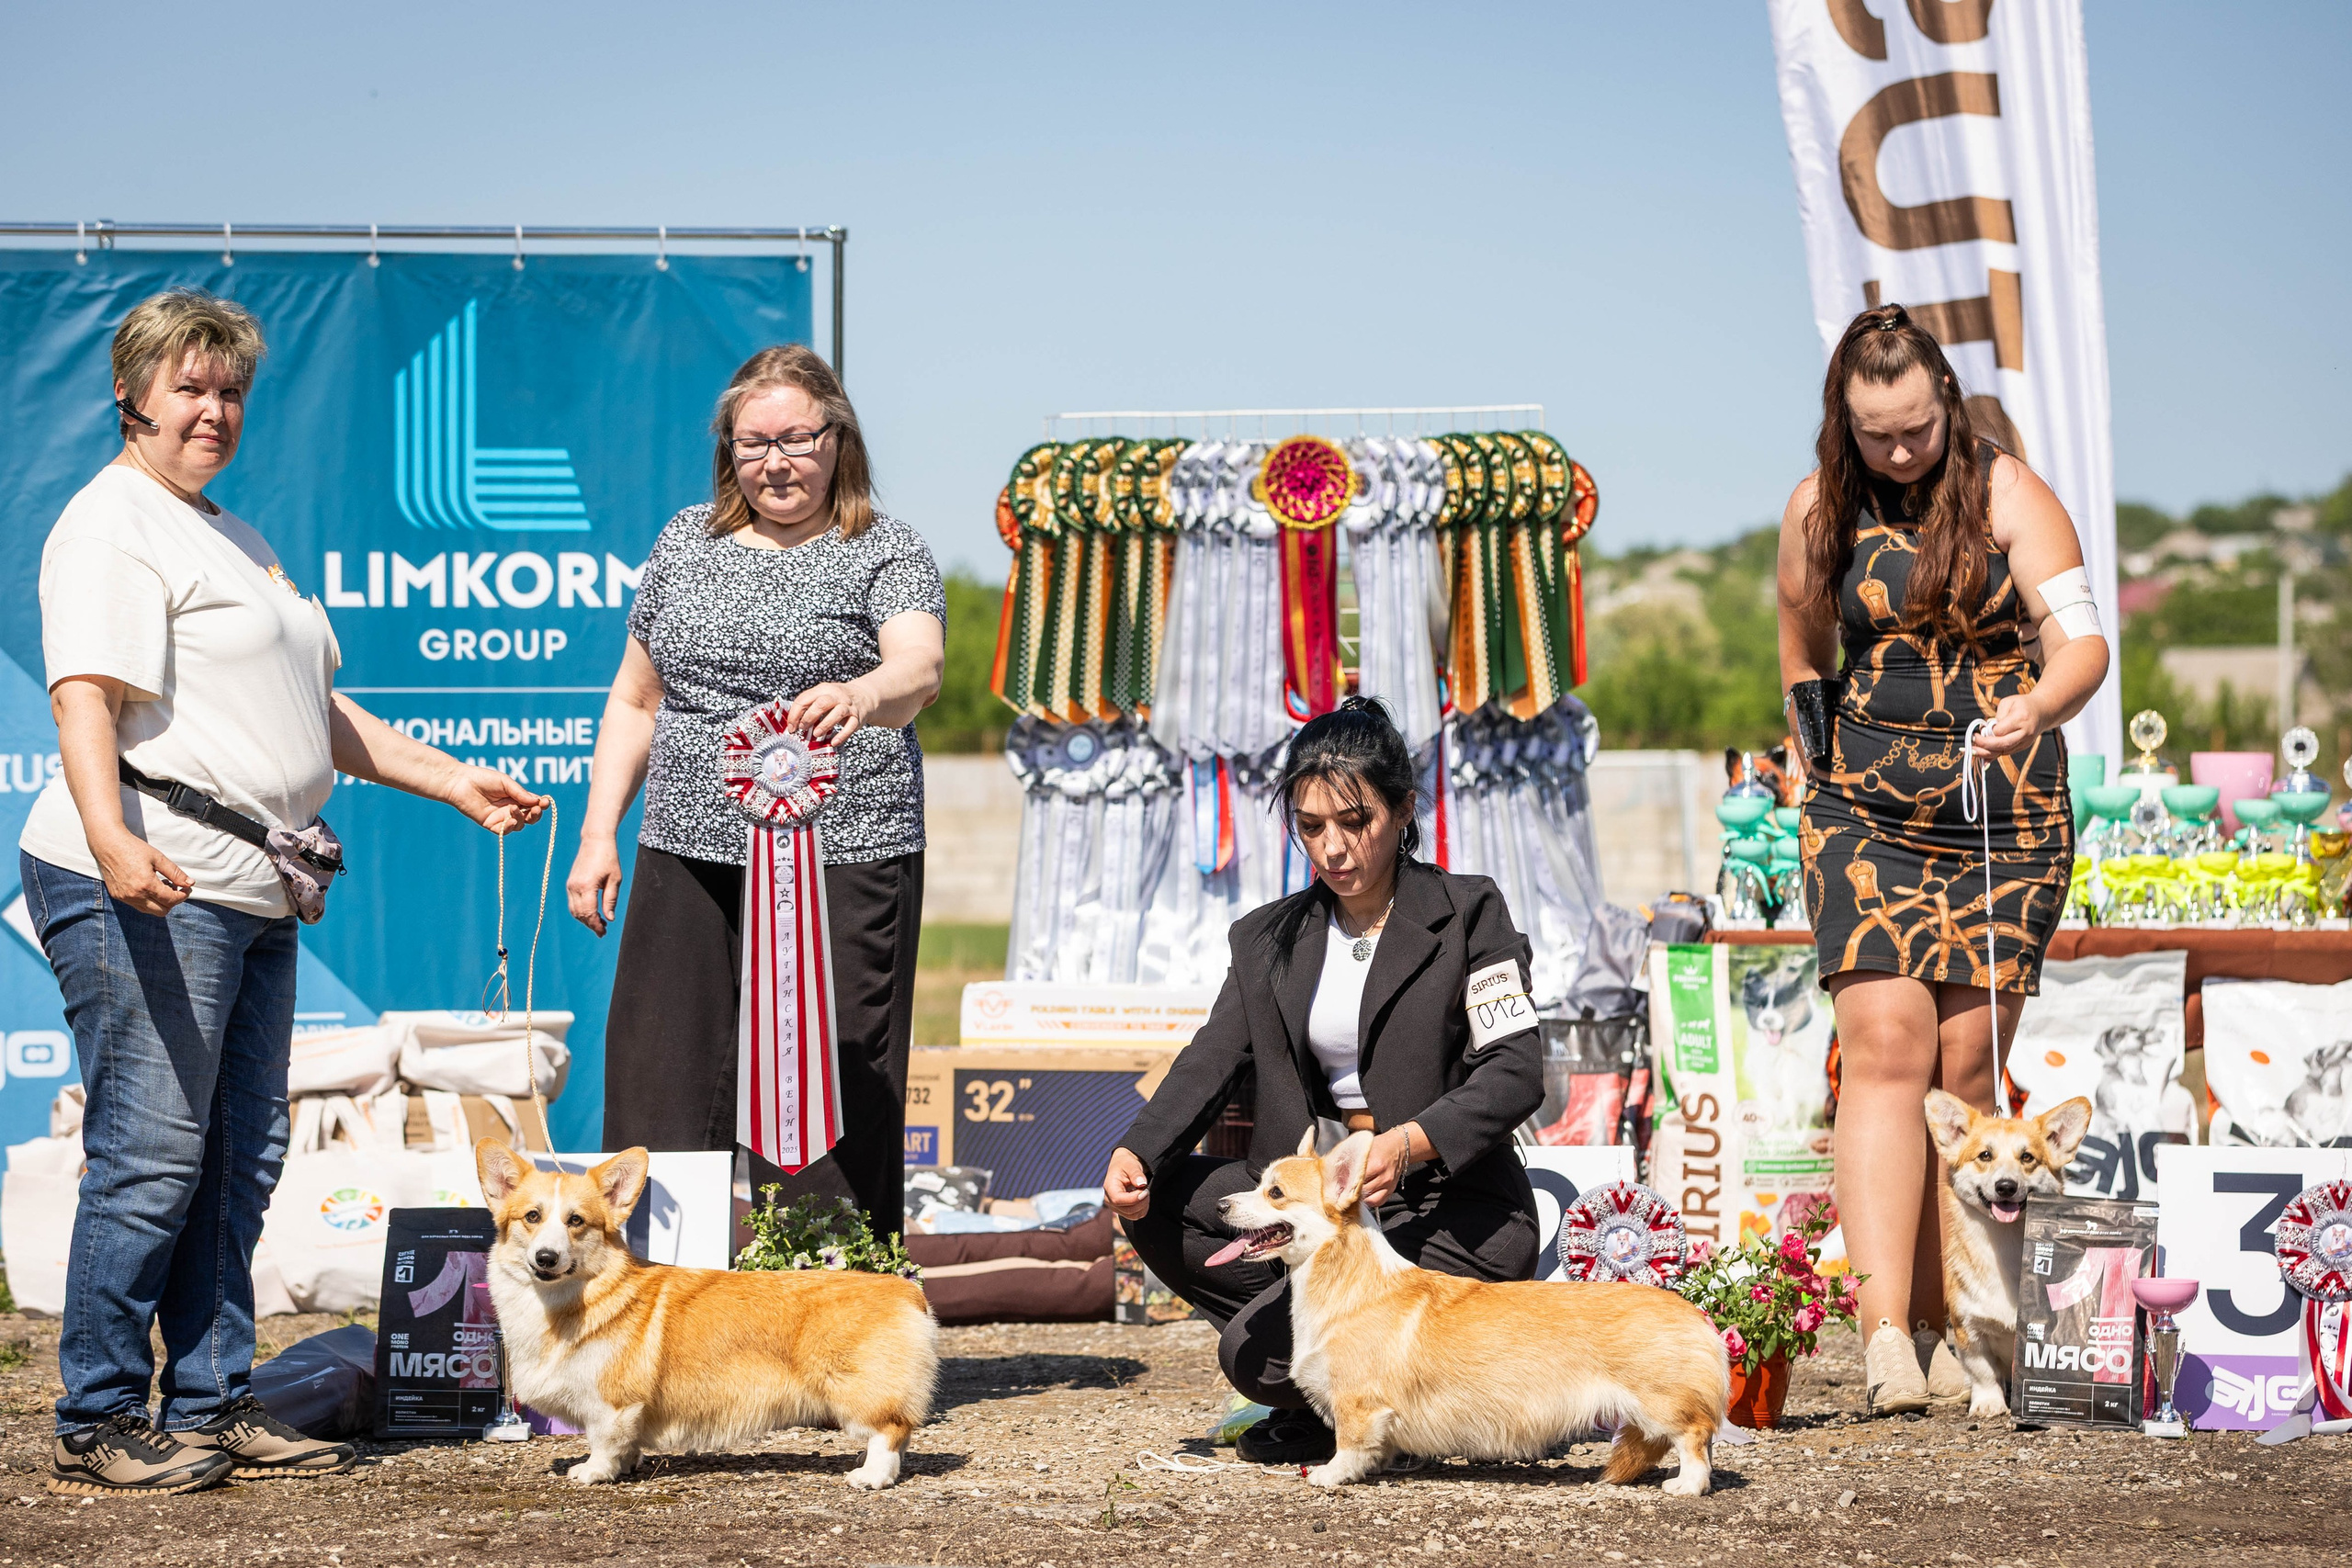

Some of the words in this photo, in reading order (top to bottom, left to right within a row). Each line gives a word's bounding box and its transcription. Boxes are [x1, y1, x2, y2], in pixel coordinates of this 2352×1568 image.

[324, 551, 649, 608] LIMKORM
[419, 629, 568, 660] GROUP
[782, 931, 793, 1057] ЛУГАНСКАЯ
[1471, 973, 1510, 995] SIRIUS
[1477, 994, 1525, 1029] 012
[1680, 1032, 1713, 1049] ADULT
[785, 1076, 795, 1143] ВЕСНА
[2207, 1172, 2304, 1337] 3
[2088, 1325, 2132, 1338] ОДНО
[390, 1352, 498, 1379] МЯСО
[2024, 1342, 2132, 1374] МЯСО
[2029, 1385, 2056, 1393] ИНДЕЙКА
